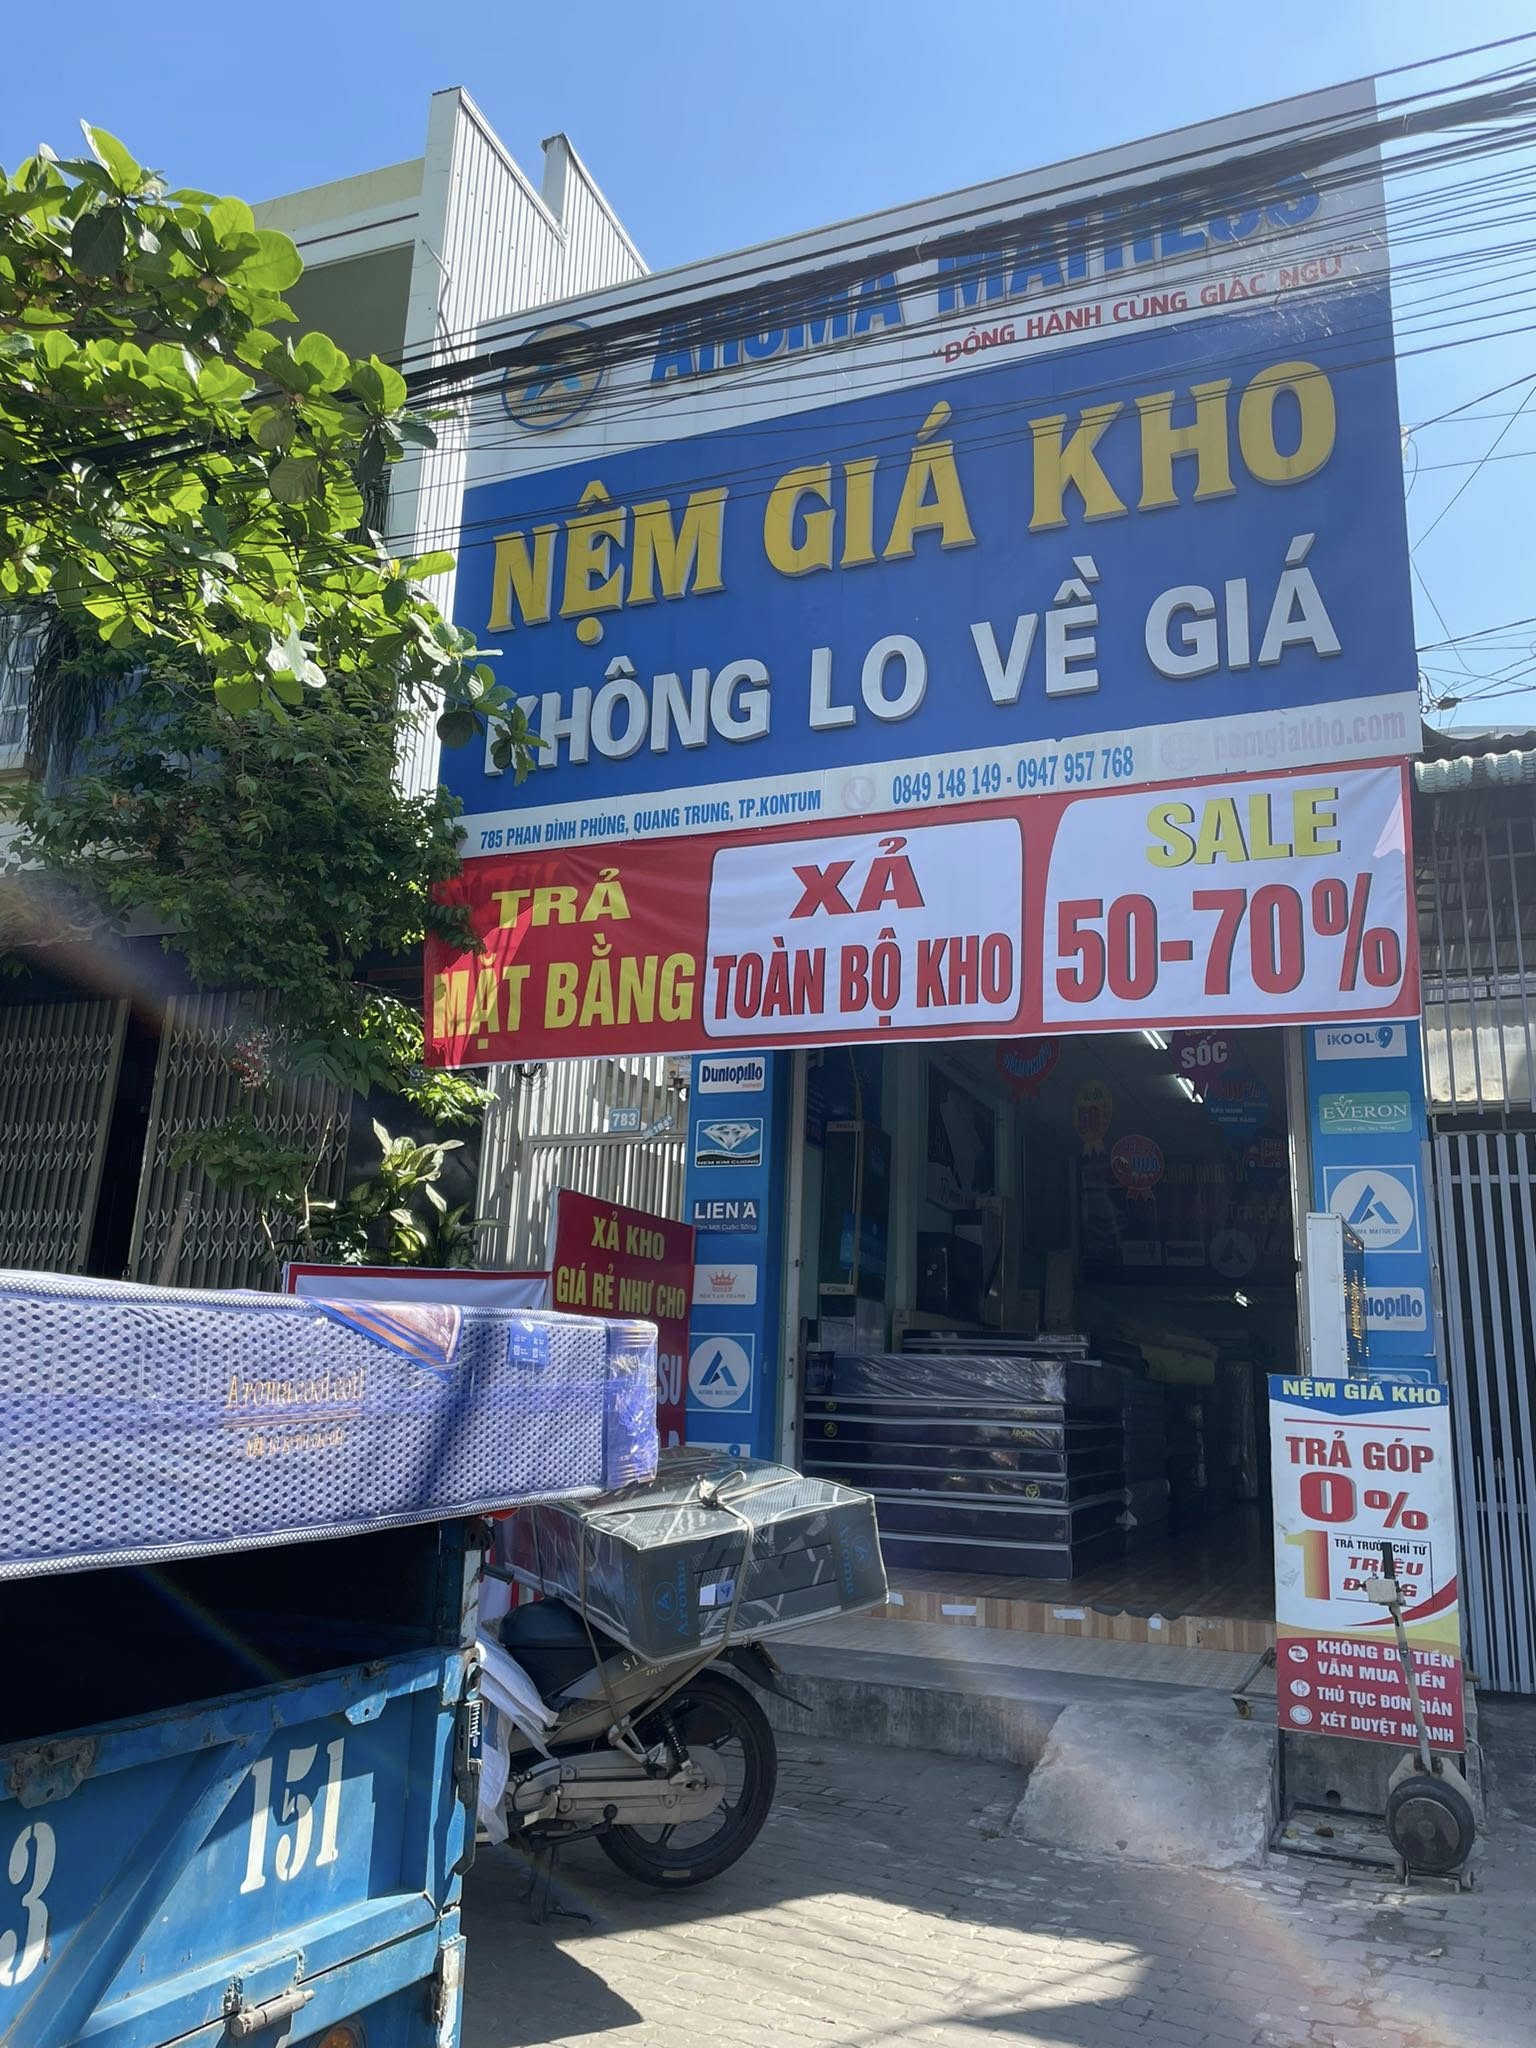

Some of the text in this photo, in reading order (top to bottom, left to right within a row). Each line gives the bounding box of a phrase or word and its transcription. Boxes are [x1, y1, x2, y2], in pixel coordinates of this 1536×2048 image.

[1027, 304, 1102, 338] HÀNH
[1112, 290, 1188, 324] CÙNG
[487, 361, 1336, 646] NỆM GIÁ KHO
[484, 533, 1341, 776] KHÔNG LO VỀ GIÁ
[892, 770, 931, 804] 0849
[937, 766, 966, 799] 148
[971, 762, 1001, 796] 149
[1017, 755, 1057, 791] 0947
[1063, 750, 1095, 785] 957
[1101, 744, 1134, 778] 768
[480, 829, 502, 850] 785
[506, 824, 542, 848] PHAN
[545, 817, 577, 843] ĐÌNH
[580, 812, 629, 838] PHÙNG,
[633, 806, 681, 833] QUANG
[684, 799, 734, 826] TRUNG,
[1146, 787, 1342, 869] SALE
[491, 868, 631, 928] TRẢ
[789, 836, 925, 920] XẢ
[1056, 872, 1403, 1004] 50-70%
[432, 932, 696, 1050] MẶT BẰNG
[712, 927, 1014, 1027] TOÀN BỘ KHO
[701, 1062, 763, 1085] Dunlopillo
[1180, 1036, 1228, 1069] SỐC
[612, 1113, 637, 1127] 783
[1323, 1103, 1407, 1120] EVERON
[591, 1210, 665, 1261] XẢ KHO
[556, 1262, 686, 1320] GIÁ RẺ NHƯ CHO
[1282, 1376, 1442, 1404] NỆM GIÁ KHO
[1285, 1430, 1435, 1473] TRẢ GÓP
[1284, 1530, 1331, 1601] 1
[1334, 1535, 1428, 1556] TRẢ TRƯỚ CHỈ TỪ
[1348, 1556, 1424, 1577] TRỆU
[1343, 1577, 1418, 1598] ĐG
[1316, 1639, 1378, 1660] KHÔNG
[1412, 1649, 1455, 1669] TIỀN
[1316, 1658, 1354, 1678] VẪN
[1359, 1666, 1400, 1684] MUA
[1316, 1684, 1345, 1703] THỦ
[1348, 1690, 1376, 1708] TỤC
[1380, 1694, 1412, 1711] ĐƠN
[1320, 1710, 1347, 1729] XÉT
[1351, 1716, 1397, 1737] DUYỆT
[240, 1738, 345, 1894] 151
